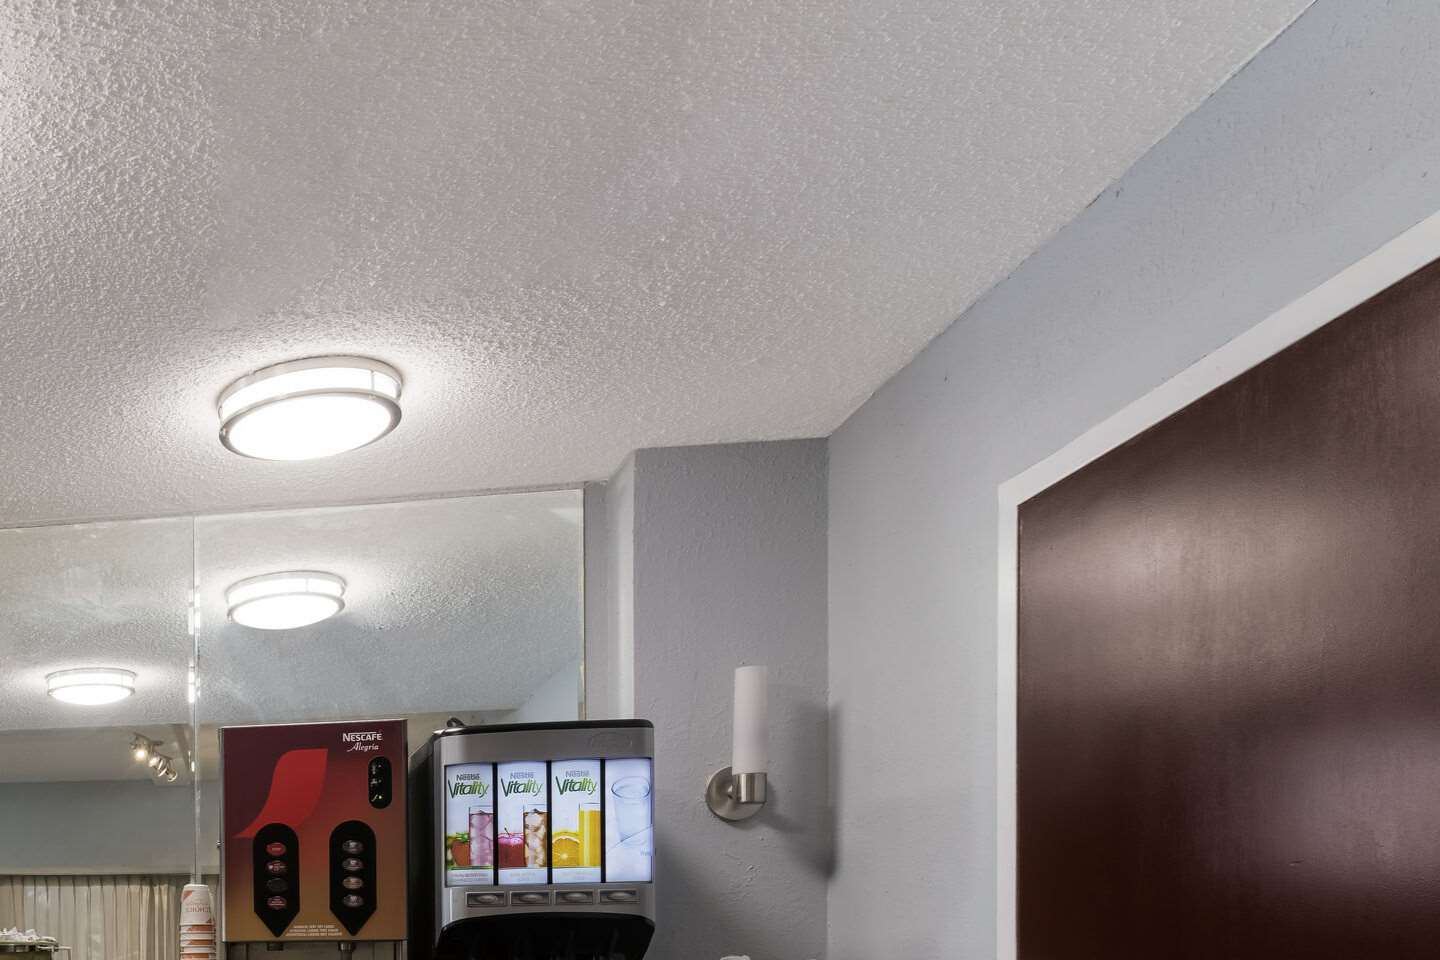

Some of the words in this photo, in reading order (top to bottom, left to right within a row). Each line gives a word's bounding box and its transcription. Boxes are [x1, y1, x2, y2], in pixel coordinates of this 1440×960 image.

[448, 779, 489, 798] Vitality
[501, 779, 543, 797] Vitality
[555, 776, 597, 795] Vitality
